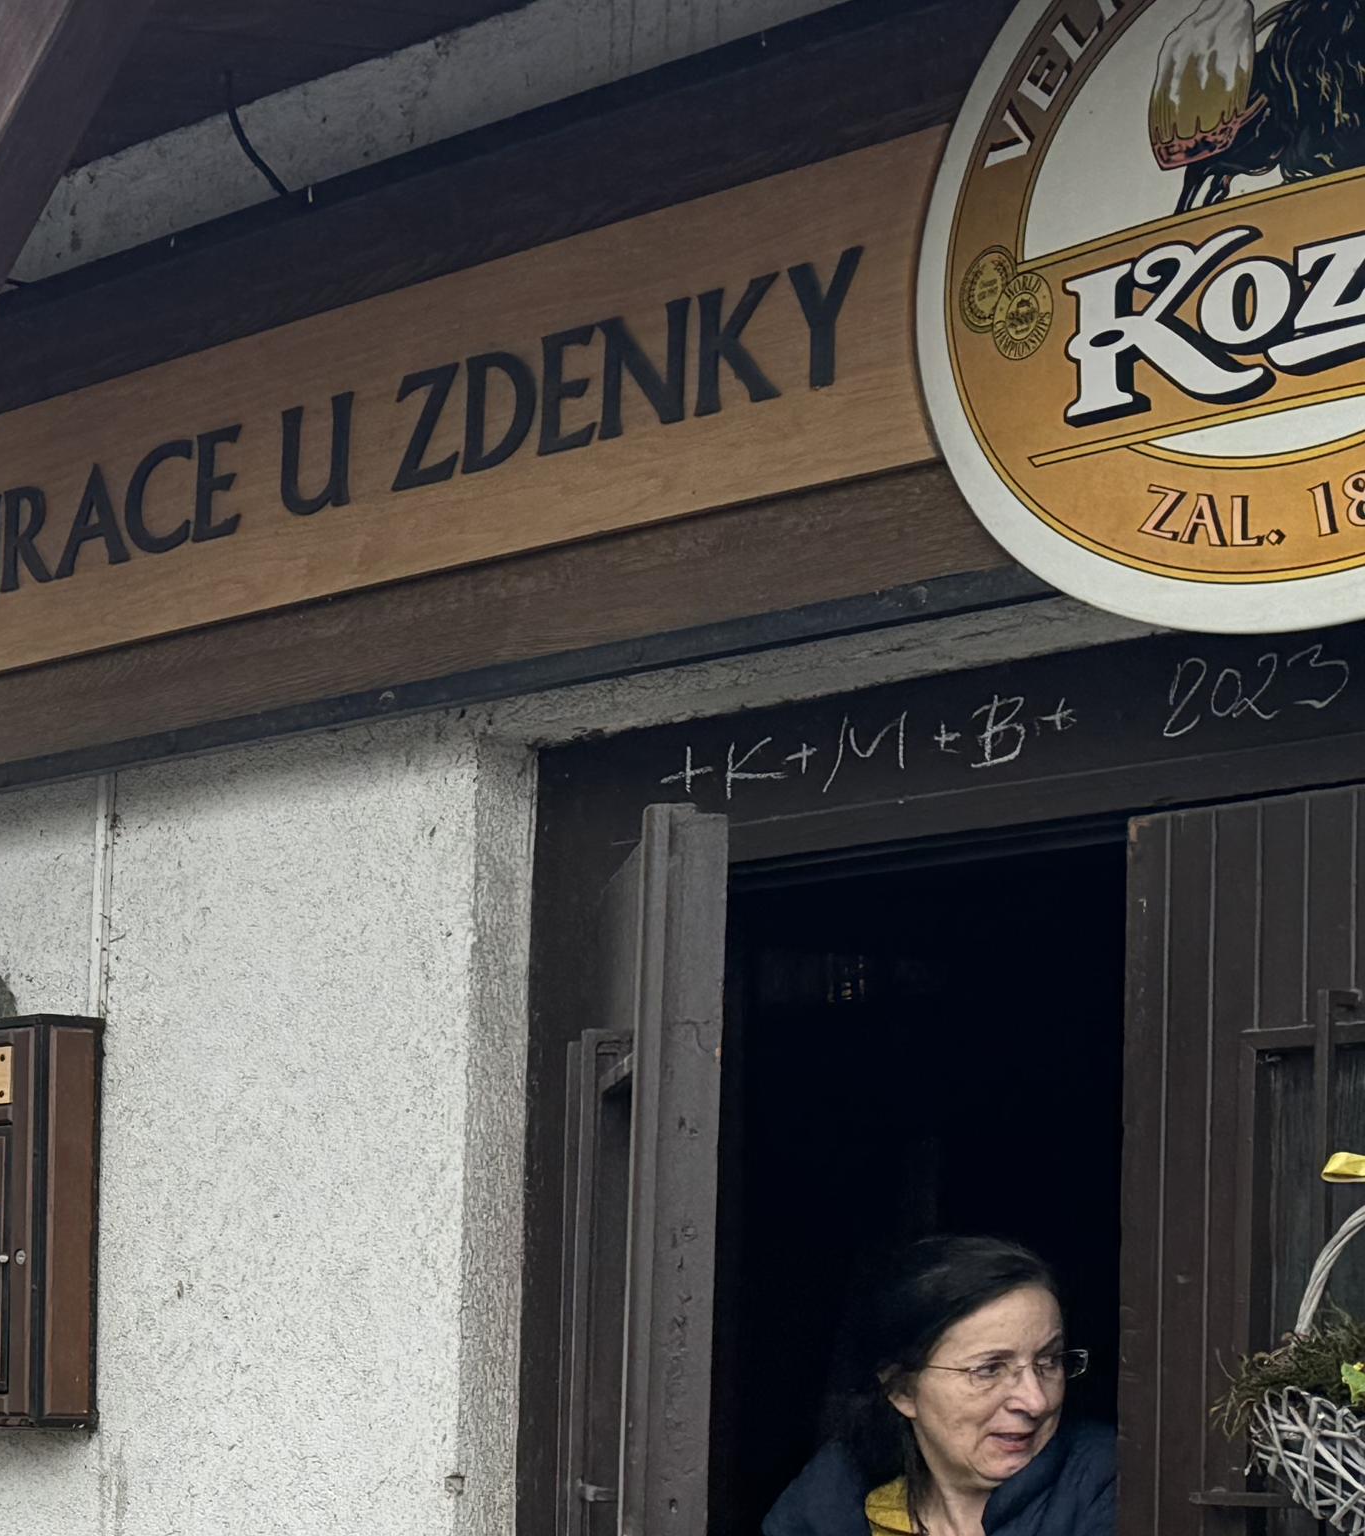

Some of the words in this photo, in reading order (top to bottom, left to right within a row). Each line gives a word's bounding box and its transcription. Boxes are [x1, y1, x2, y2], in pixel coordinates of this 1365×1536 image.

[983, 0, 1119, 169] VEL
[280, 391, 353, 516] U
[391, 245, 866, 492] ZDENKY
[1137, 483, 1286, 548] ZAL.
[1163, 643, 1350, 738] 2023
